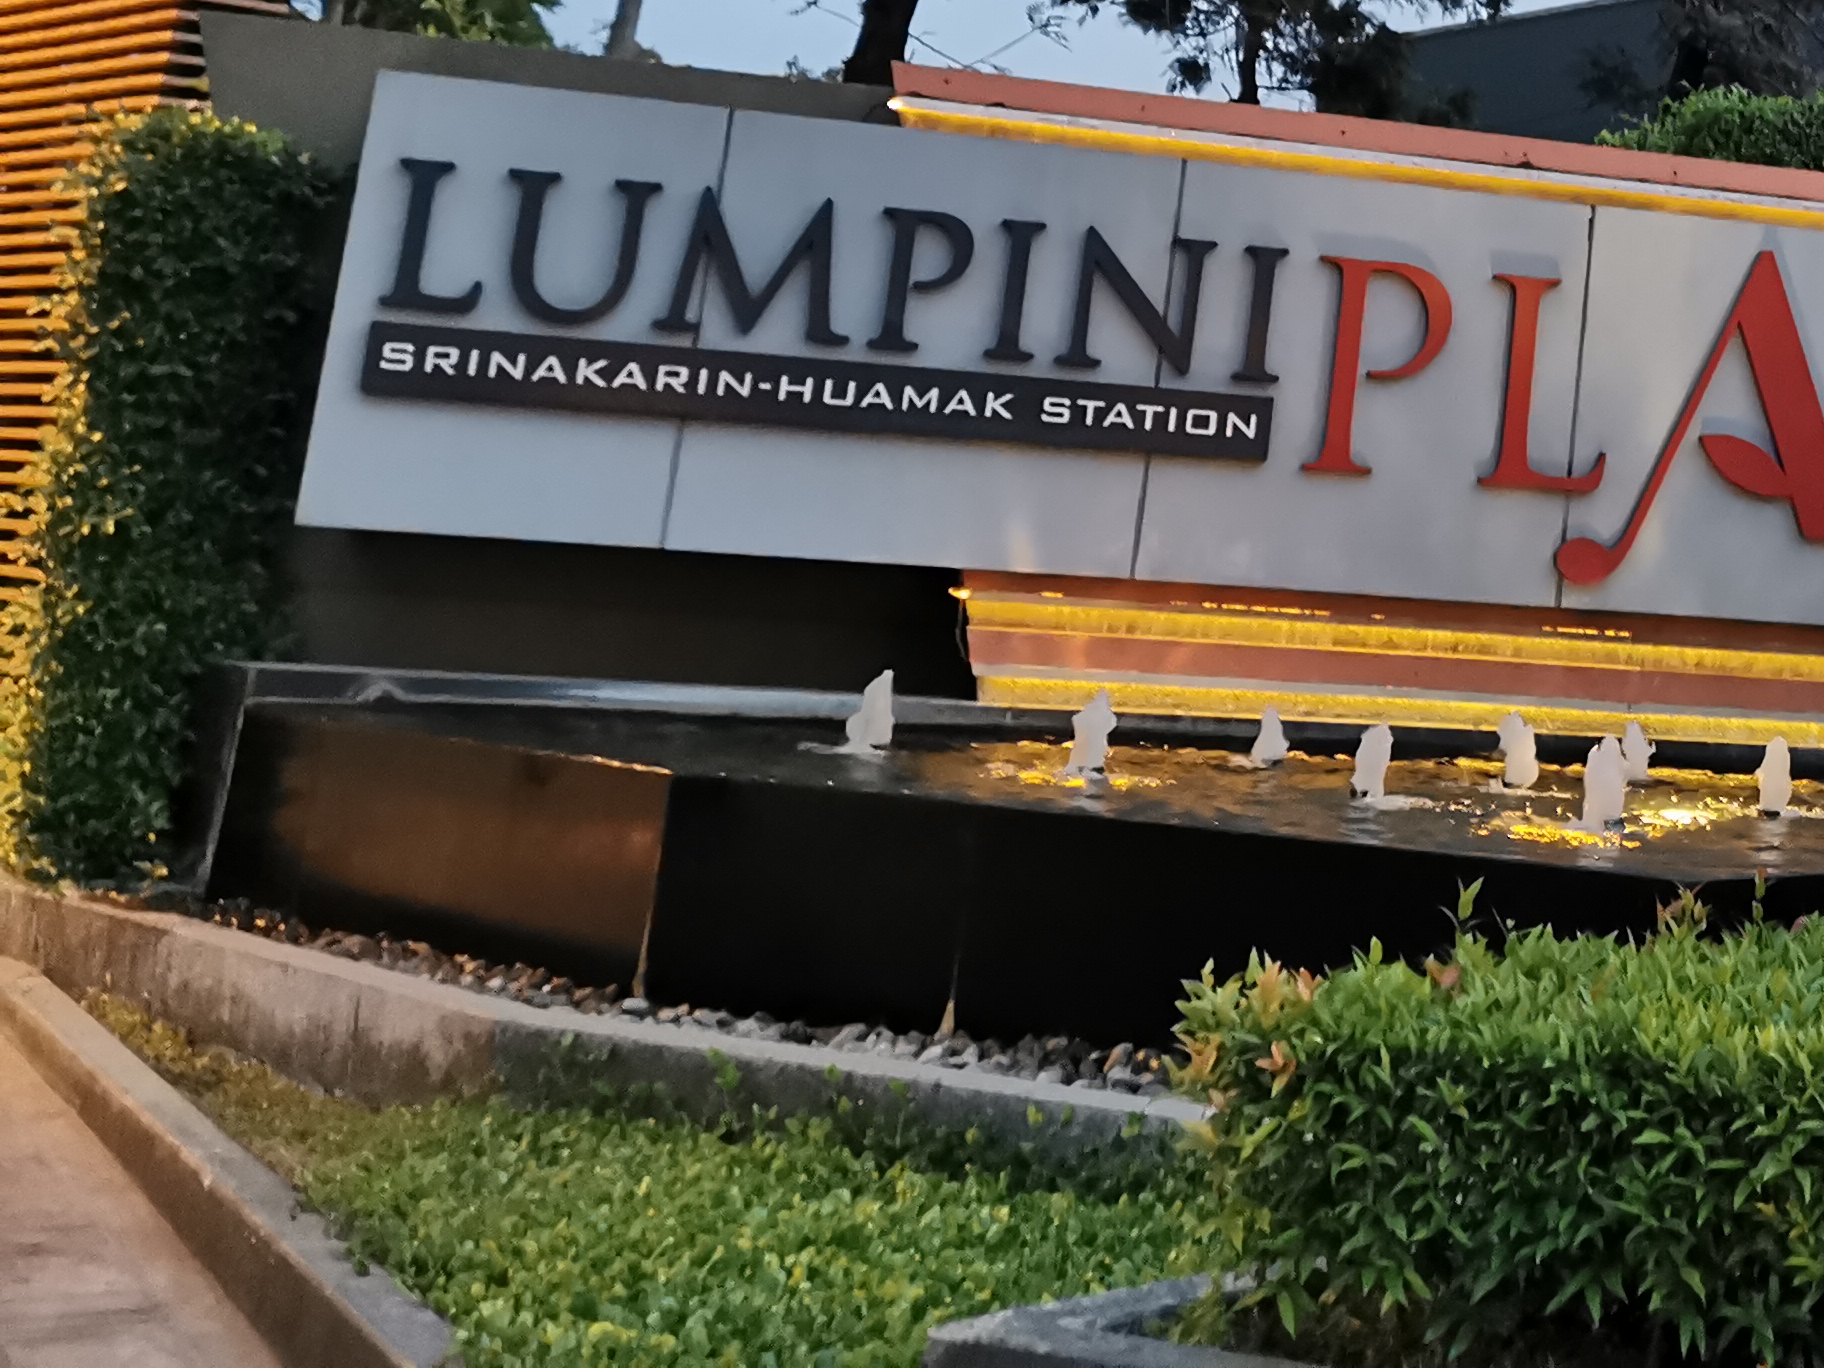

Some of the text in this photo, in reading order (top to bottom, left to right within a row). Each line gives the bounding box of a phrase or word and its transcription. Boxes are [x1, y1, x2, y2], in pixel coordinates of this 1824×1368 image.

[378, 157, 1290, 383] LUMPINI
[378, 341, 1258, 440] SRINAKARIN-HUAMAK STATION
